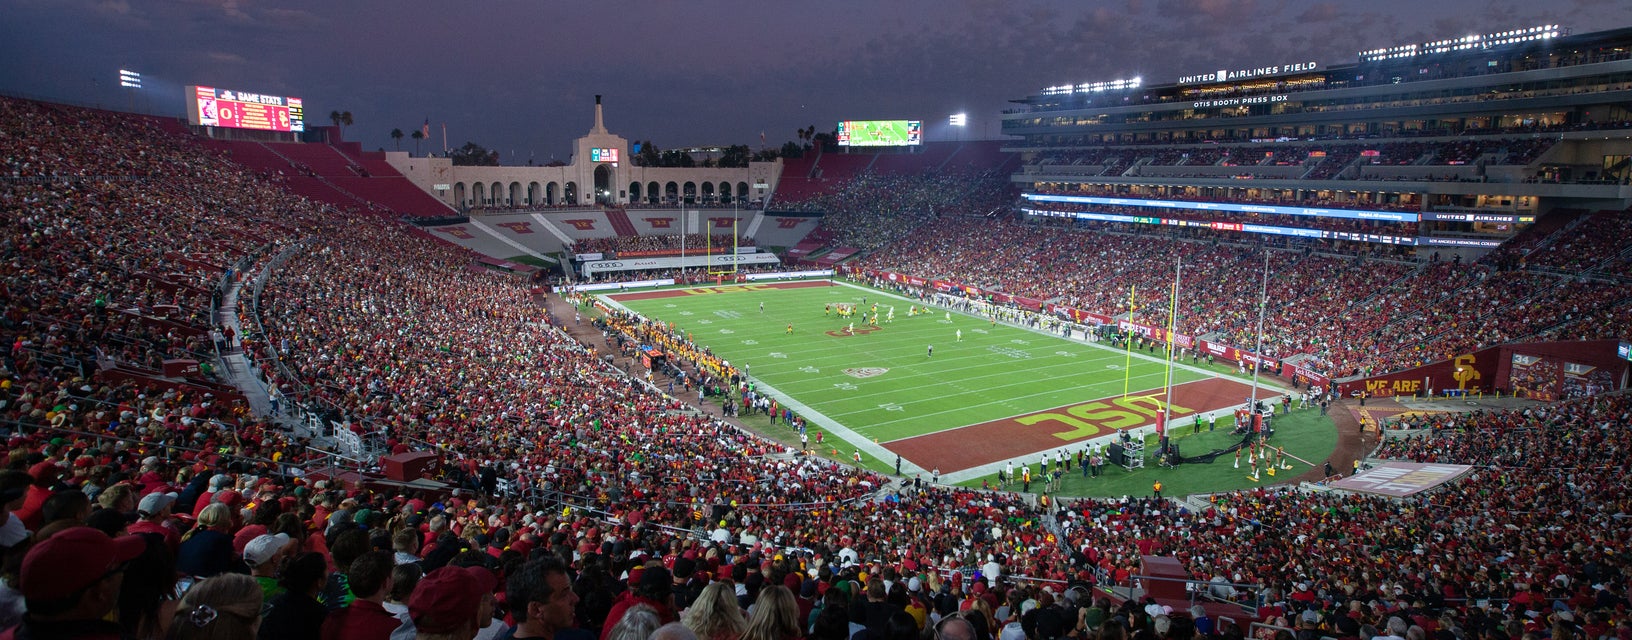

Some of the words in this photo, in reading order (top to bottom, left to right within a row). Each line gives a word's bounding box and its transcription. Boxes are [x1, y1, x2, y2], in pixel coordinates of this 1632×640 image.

[1179, 73, 1215, 83] UNITED
[1228, 66, 1279, 78] AIRLINES
[1284, 61, 1317, 72] FIELD
[238, 92, 259, 102] GAME
[260, 95, 281, 105] STATS
[1242, 96, 1268, 104] PRESS
[1271, 94, 1288, 102] BOX
[681, 284, 778, 295] USC
[1515, 355, 1529, 364] 34
[1365, 380, 1388, 393] WE
[1392, 380, 1421, 392] ARE
[1013, 395, 1195, 442] USC
